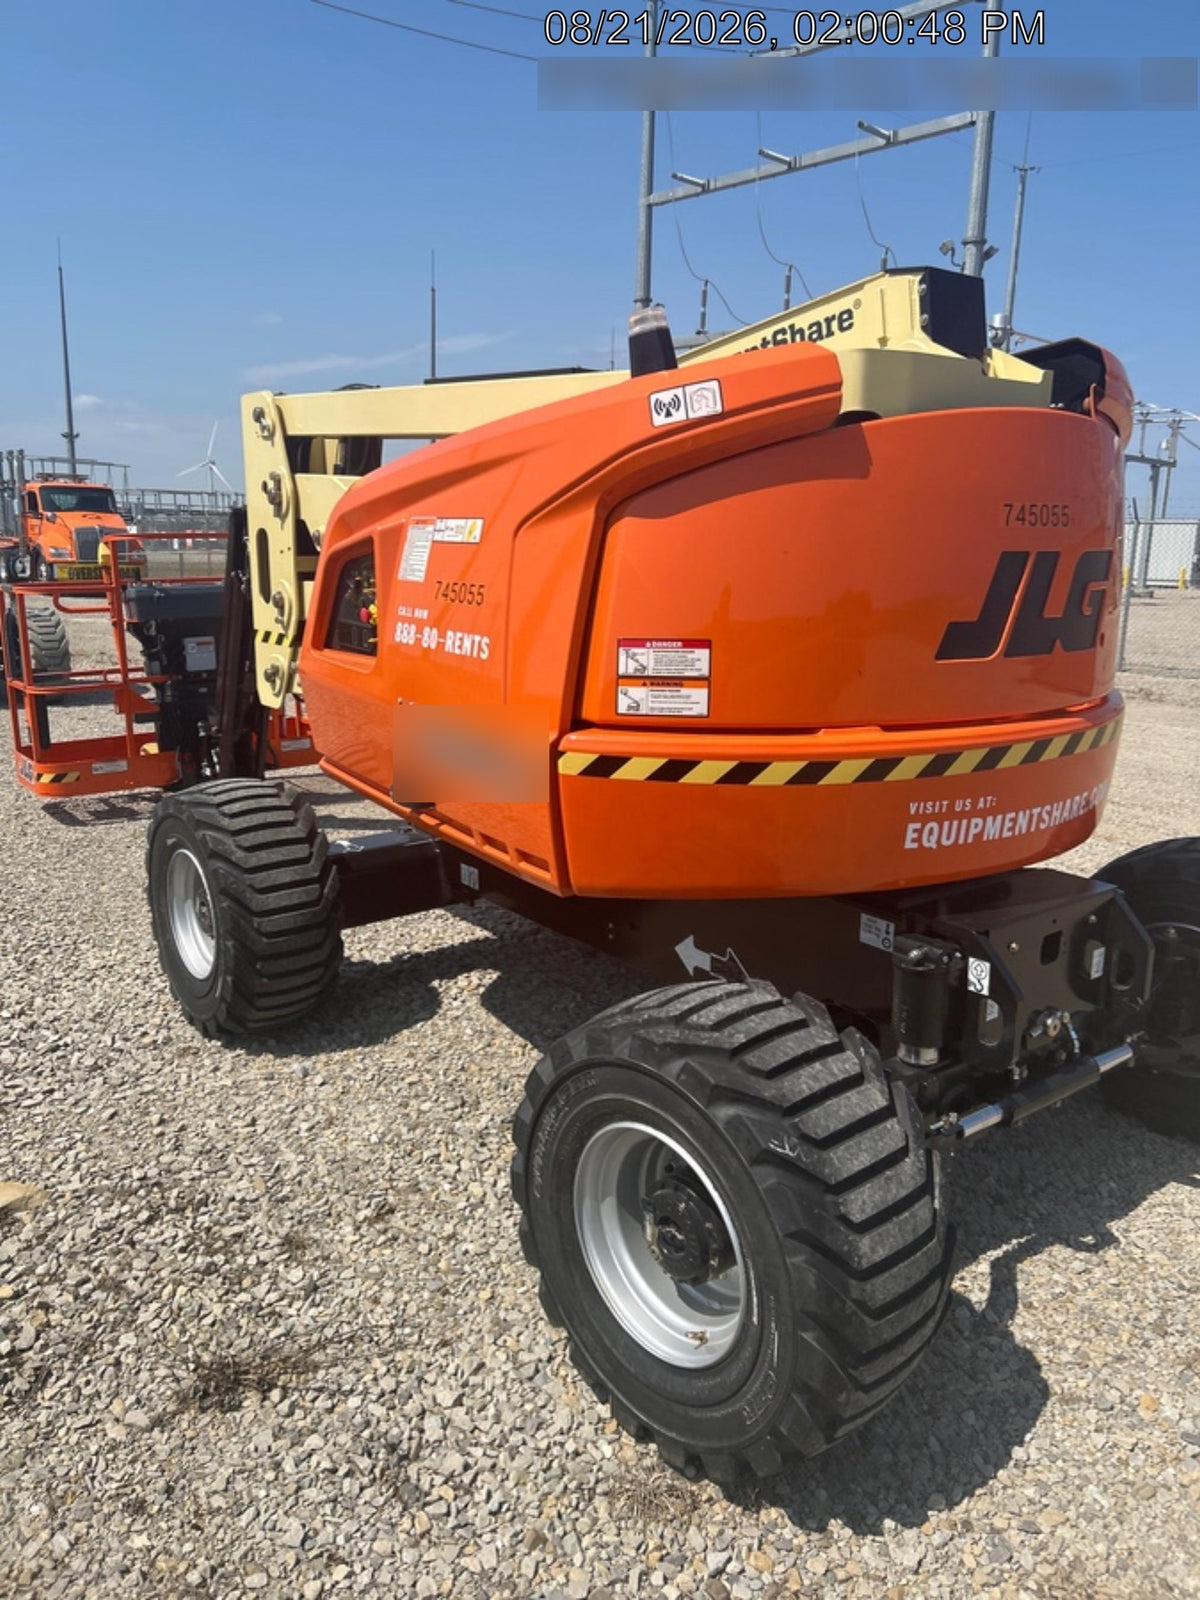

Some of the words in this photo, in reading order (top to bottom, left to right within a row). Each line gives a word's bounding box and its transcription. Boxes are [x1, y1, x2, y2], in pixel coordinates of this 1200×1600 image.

[1003, 503, 1070, 528] 745055
[434, 580, 486, 606] 745055
[934, 550, 1113, 660] JLG
[414, 607, 428, 620] NOW
[394, 621, 490, 661] 888-80-RENTS
[909, 801, 949, 816] VISIT
[954, 798, 972, 812] US
[977, 796, 997, 809] AT:
